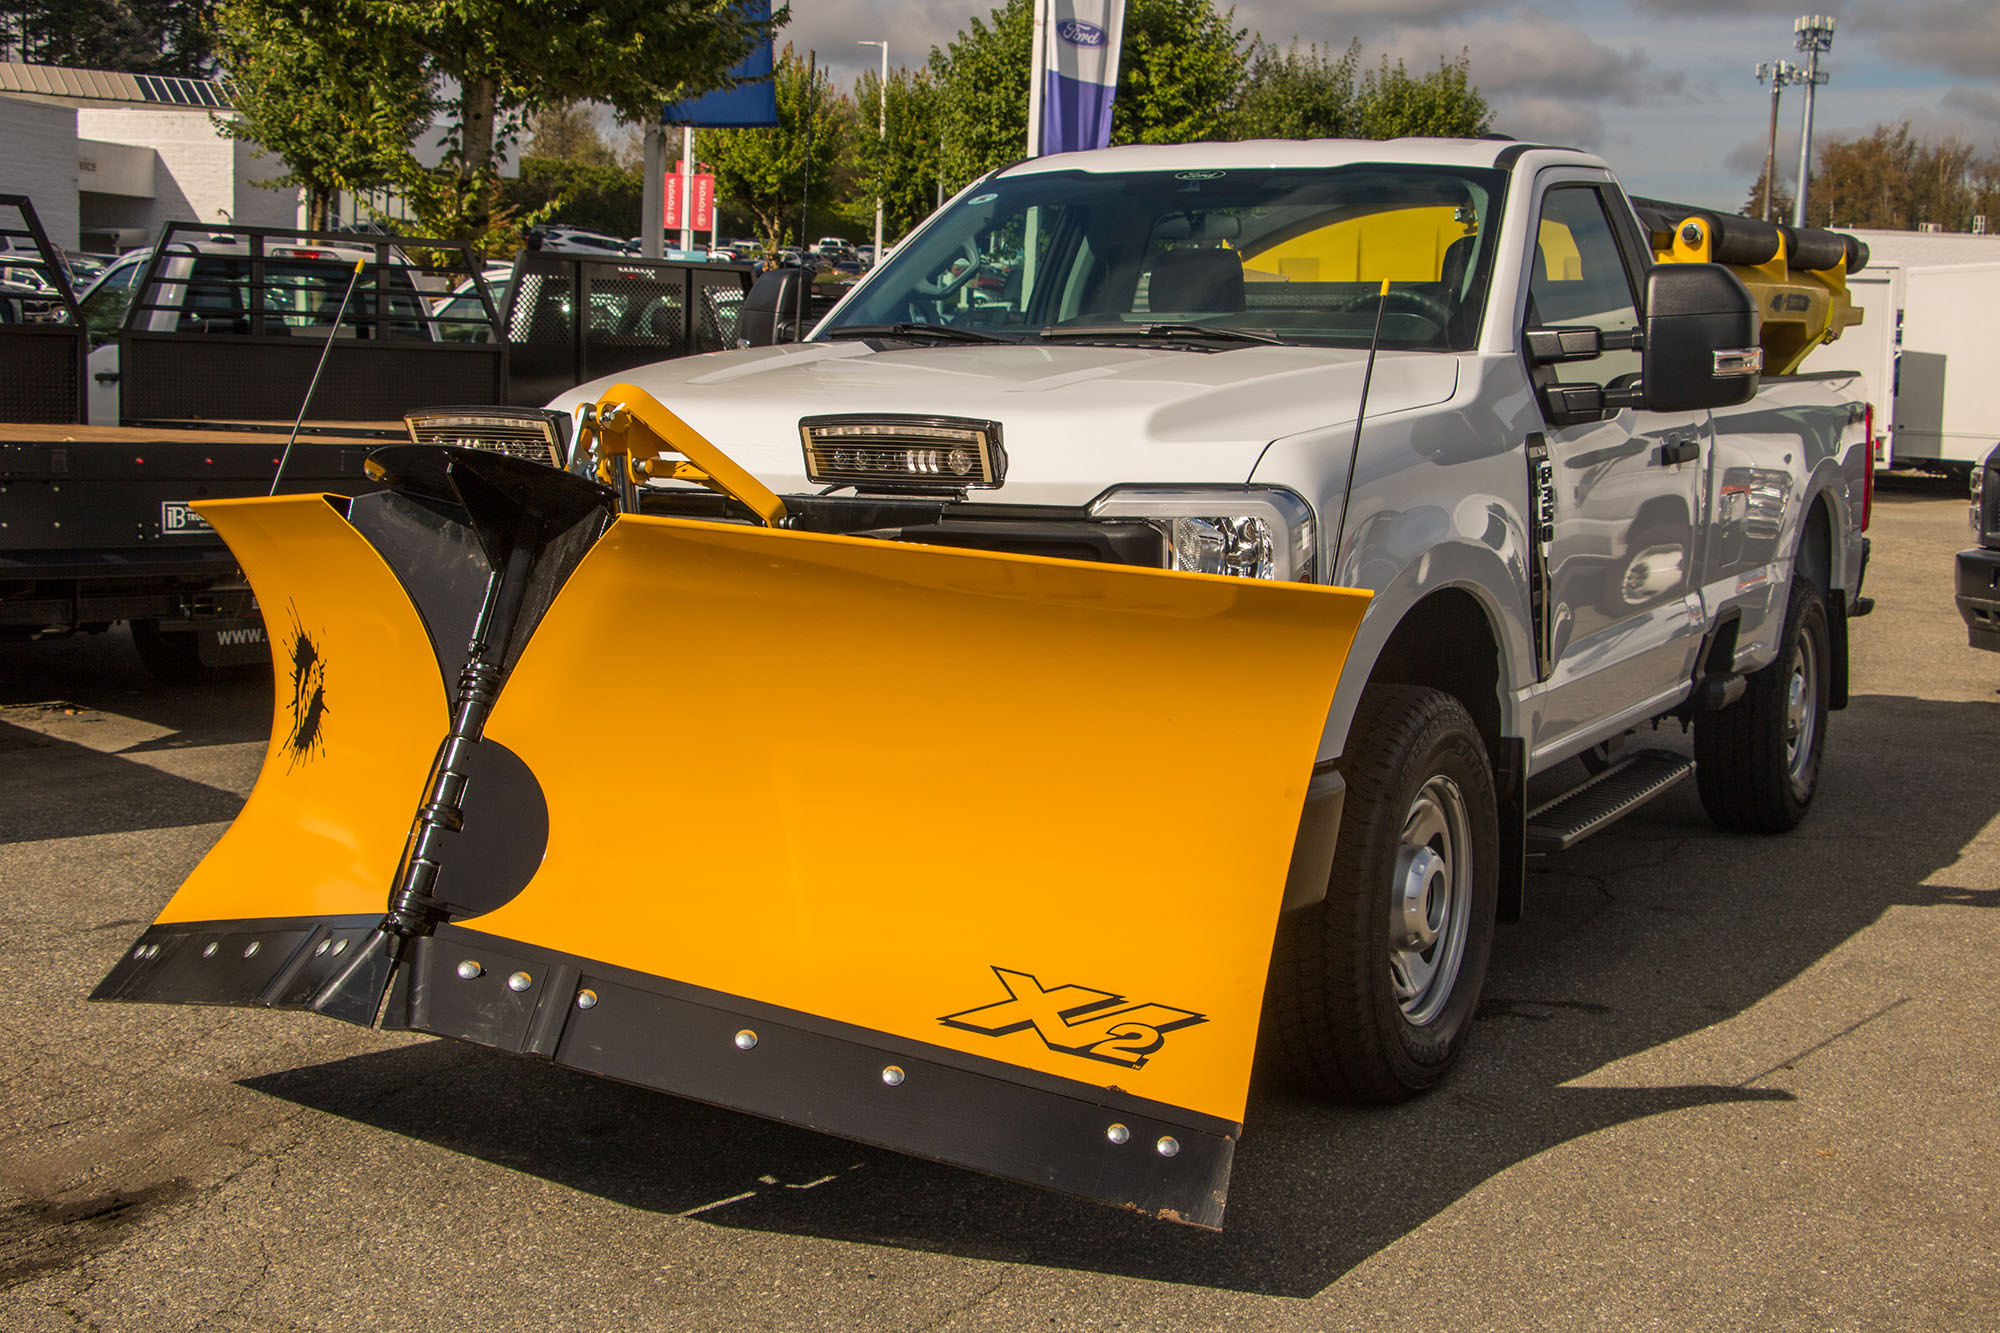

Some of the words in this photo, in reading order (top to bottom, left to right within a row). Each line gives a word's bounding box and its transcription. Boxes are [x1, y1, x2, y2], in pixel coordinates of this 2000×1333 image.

[1063, 22, 1099, 45] Ford
[667, 178, 676, 211] TOYOTA
[698, 179, 707, 213] TOYOTA
